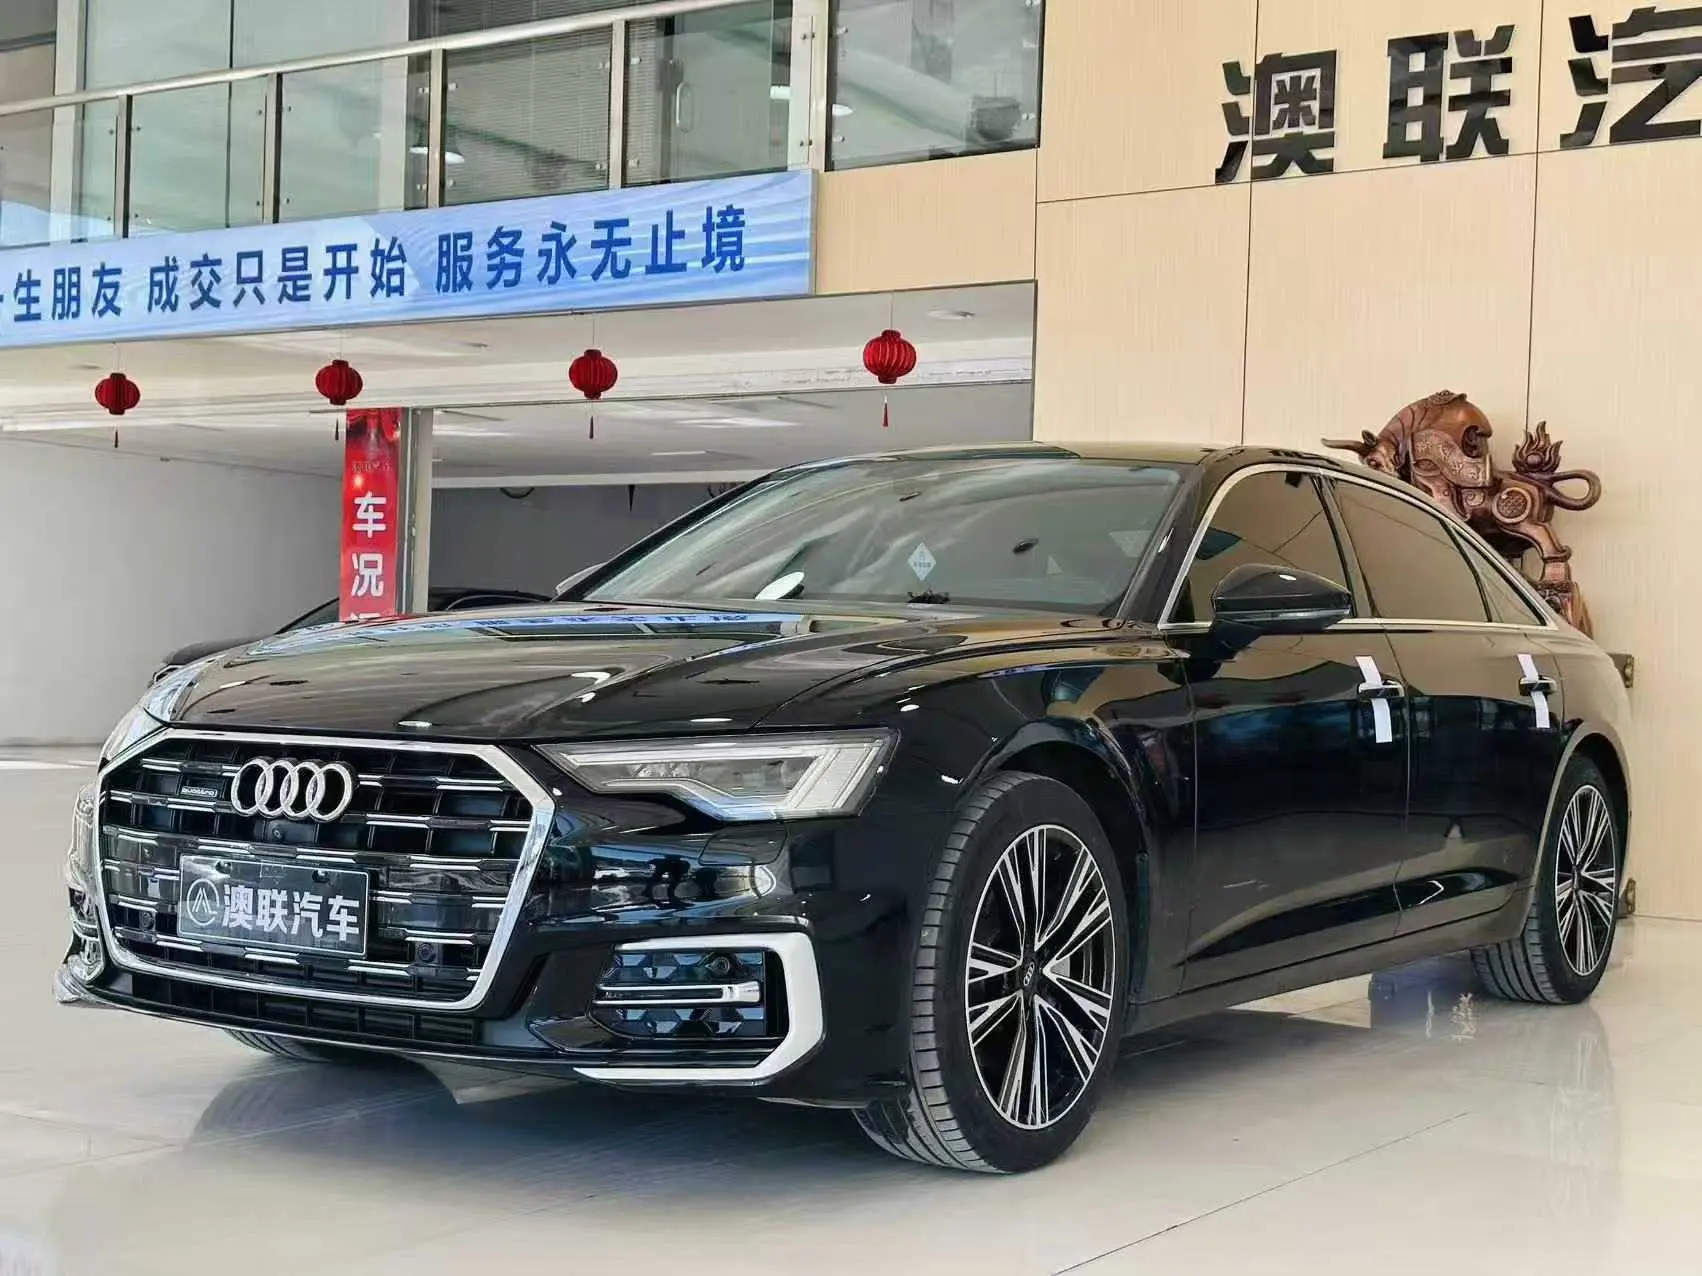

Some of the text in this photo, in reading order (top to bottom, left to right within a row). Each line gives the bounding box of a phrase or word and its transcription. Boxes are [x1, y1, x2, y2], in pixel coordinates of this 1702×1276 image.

[1215, 5, 1702, 184] 澳联汽
[0, 203, 746, 322] 生朋友 成交只是开始 服务永无止境
[350, 490, 387, 622] 车况
[221, 884, 360, 942] 澳联汽车
